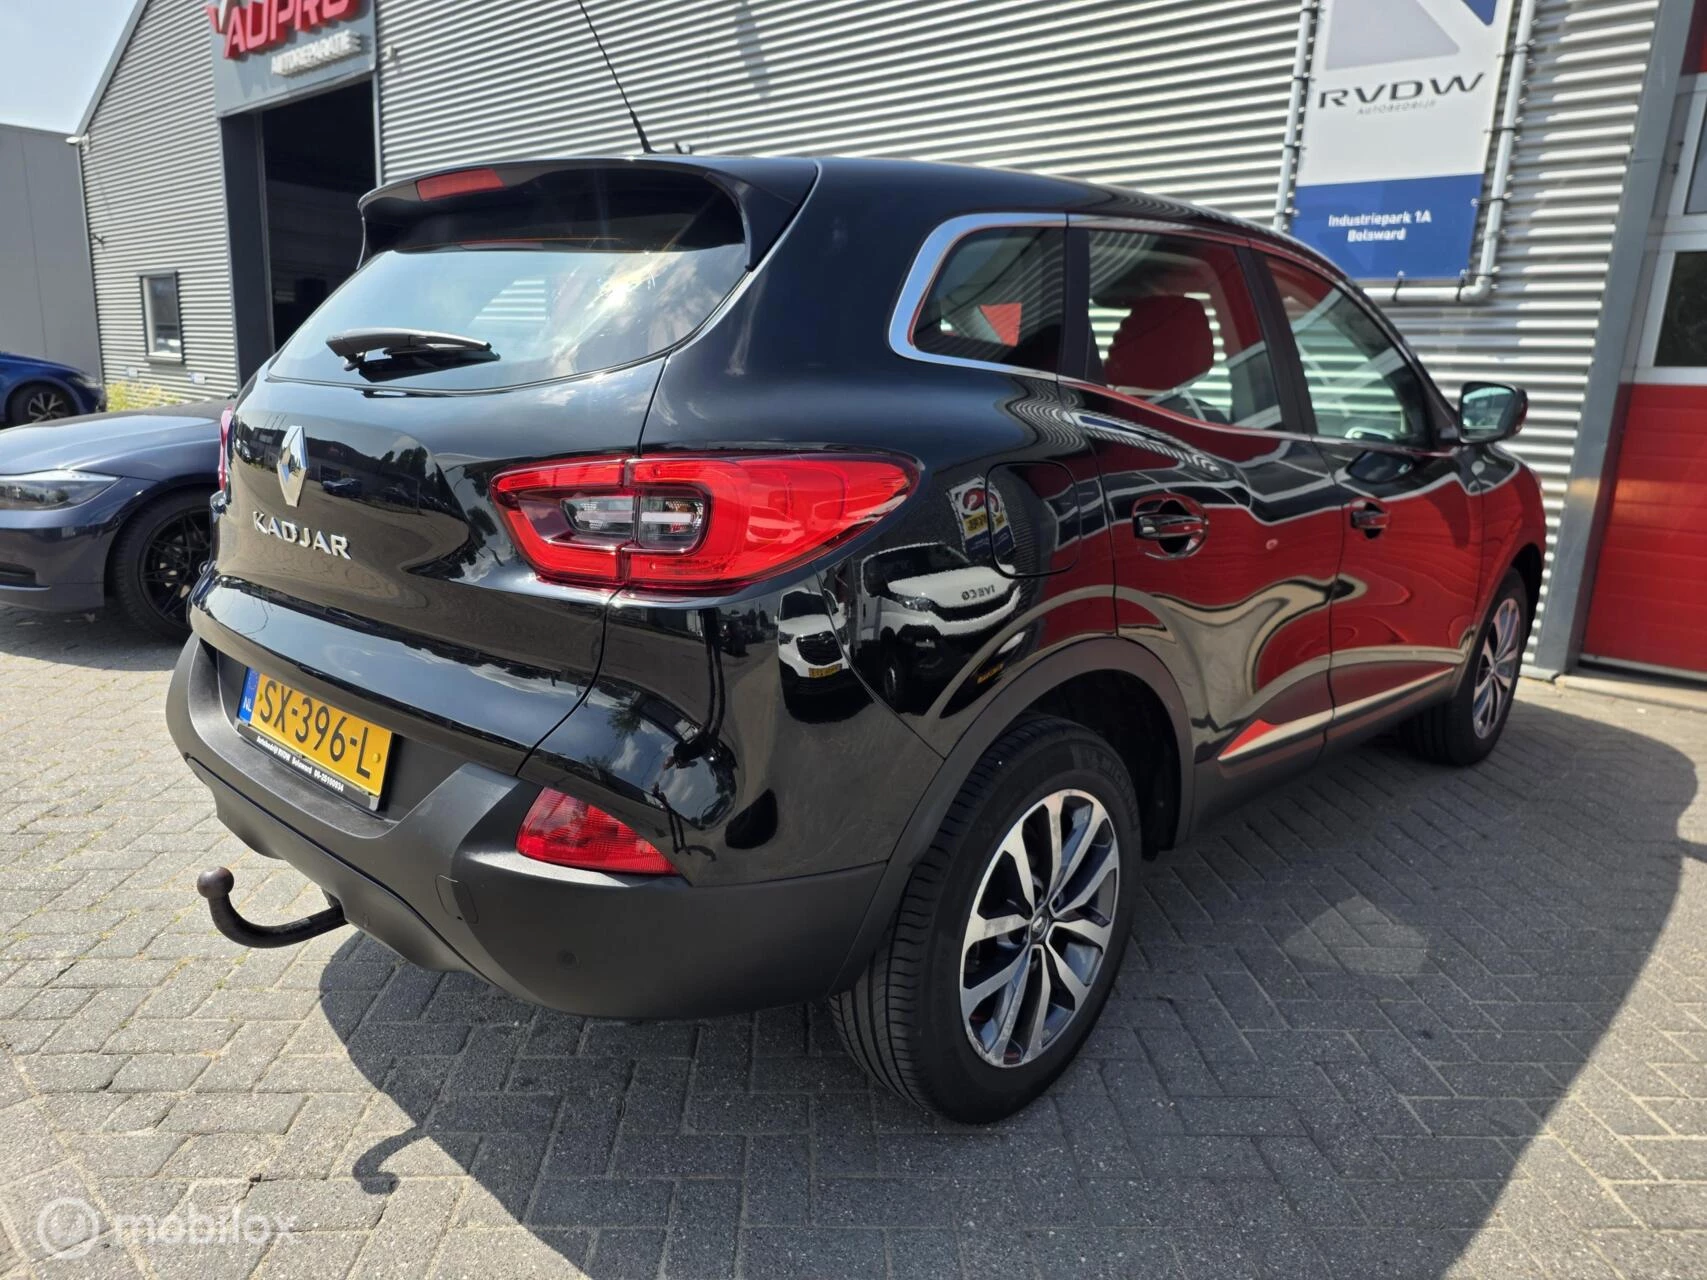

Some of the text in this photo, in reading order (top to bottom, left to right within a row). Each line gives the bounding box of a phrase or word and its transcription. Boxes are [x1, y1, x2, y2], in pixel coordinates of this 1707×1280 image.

[1318, 72, 1484, 109] RVDW
[1328, 209, 1432, 228] Industriepark 1A
[1347, 228, 1406, 242] Bolsward
[252, 511, 352, 560] KADJAR
[243, 697, 252, 713] NL
[259, 680, 371, 780] SX-396-L
